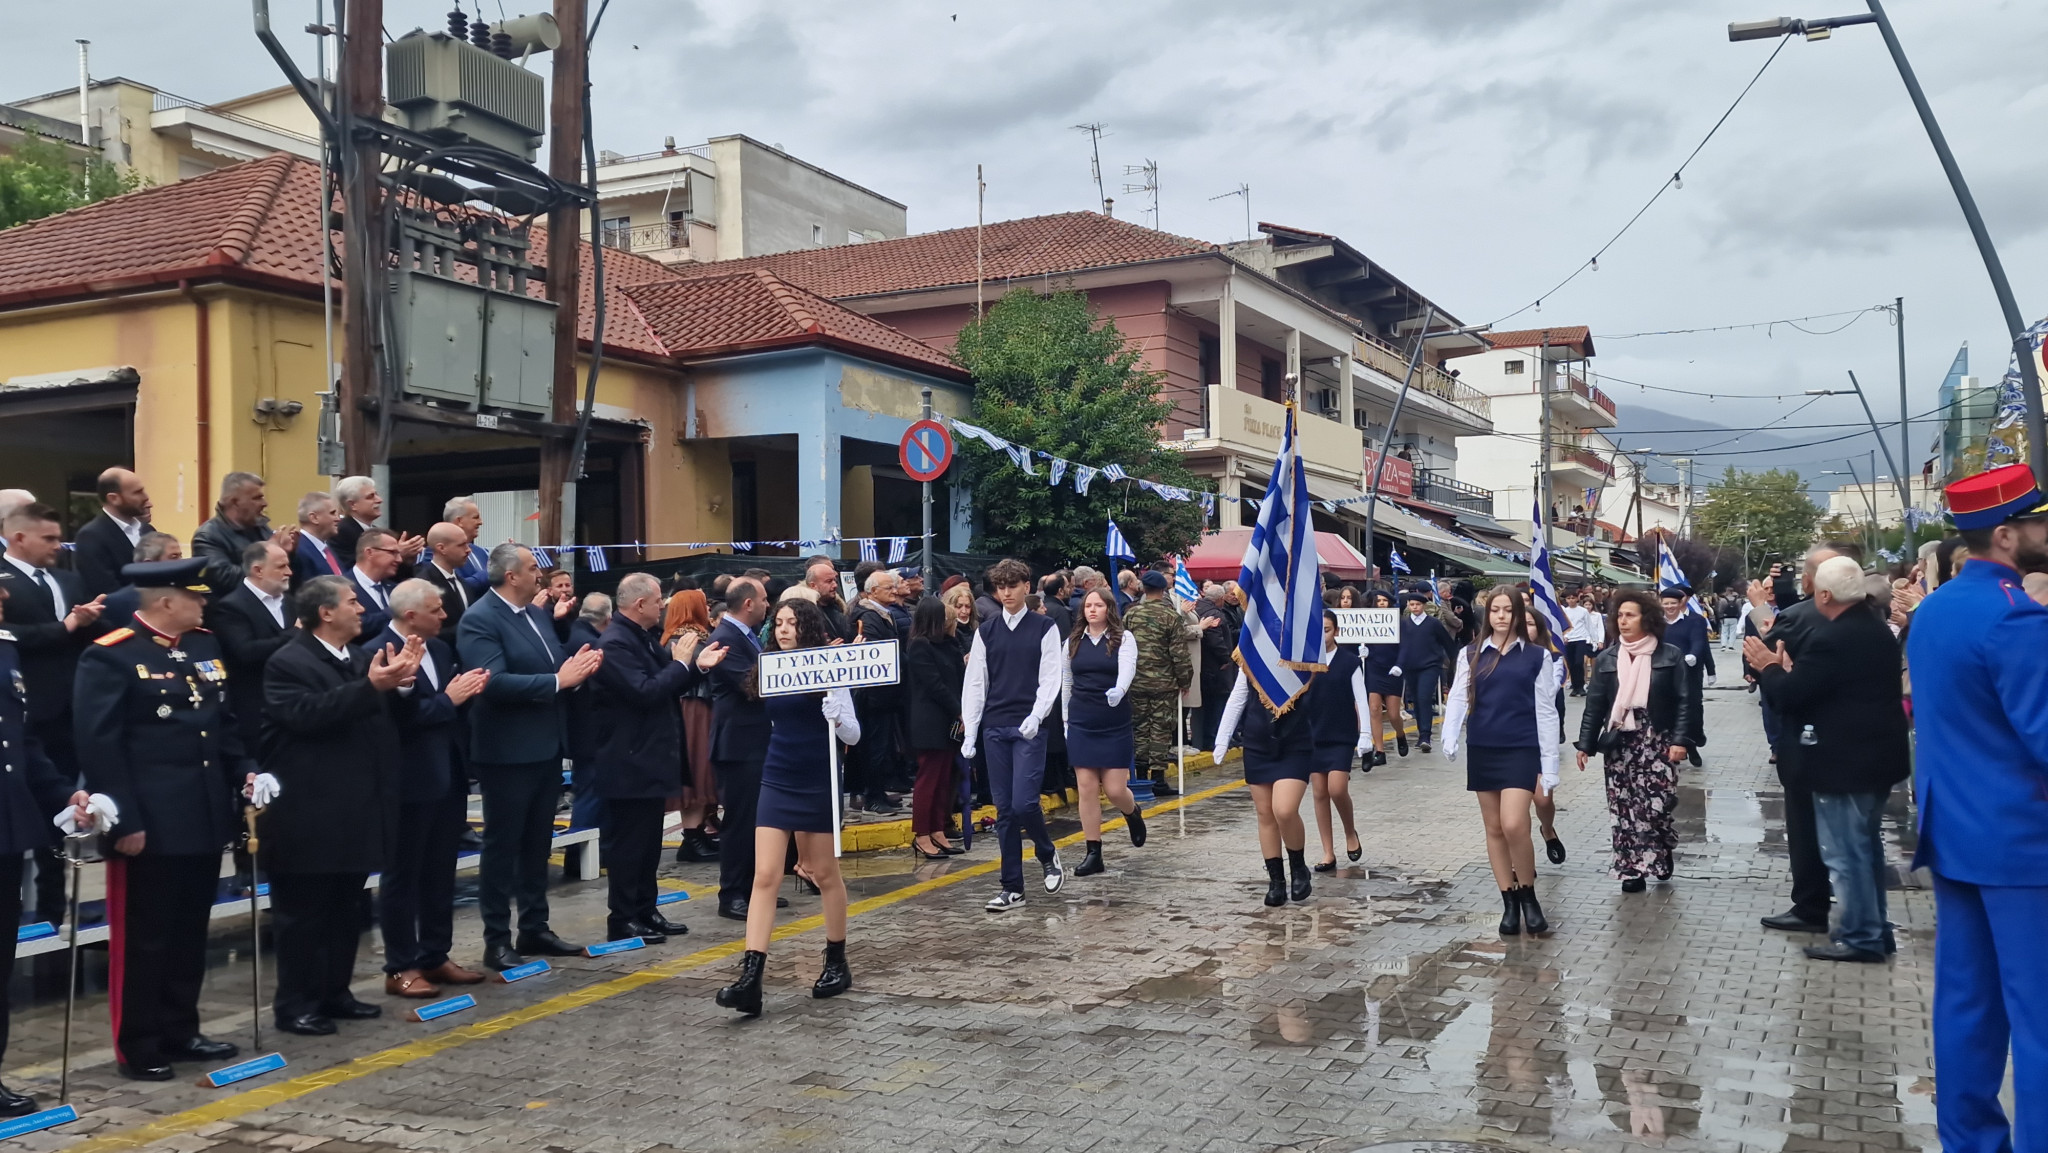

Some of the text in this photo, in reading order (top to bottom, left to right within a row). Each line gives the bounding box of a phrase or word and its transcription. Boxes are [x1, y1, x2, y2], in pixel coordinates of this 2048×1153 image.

[1261, 421, 1282, 440] PLACE
[1365, 451, 1399, 484] ΣΥΙΖΑ
[1340, 626, 1396, 637] ΡΟΜΑΧΩΝ
[776, 647, 880, 669] ΓΥΜΝΑΣΙΟ
[766, 662, 892, 689] ΠΟΛΥΚΑΡΠΙΟΥ
